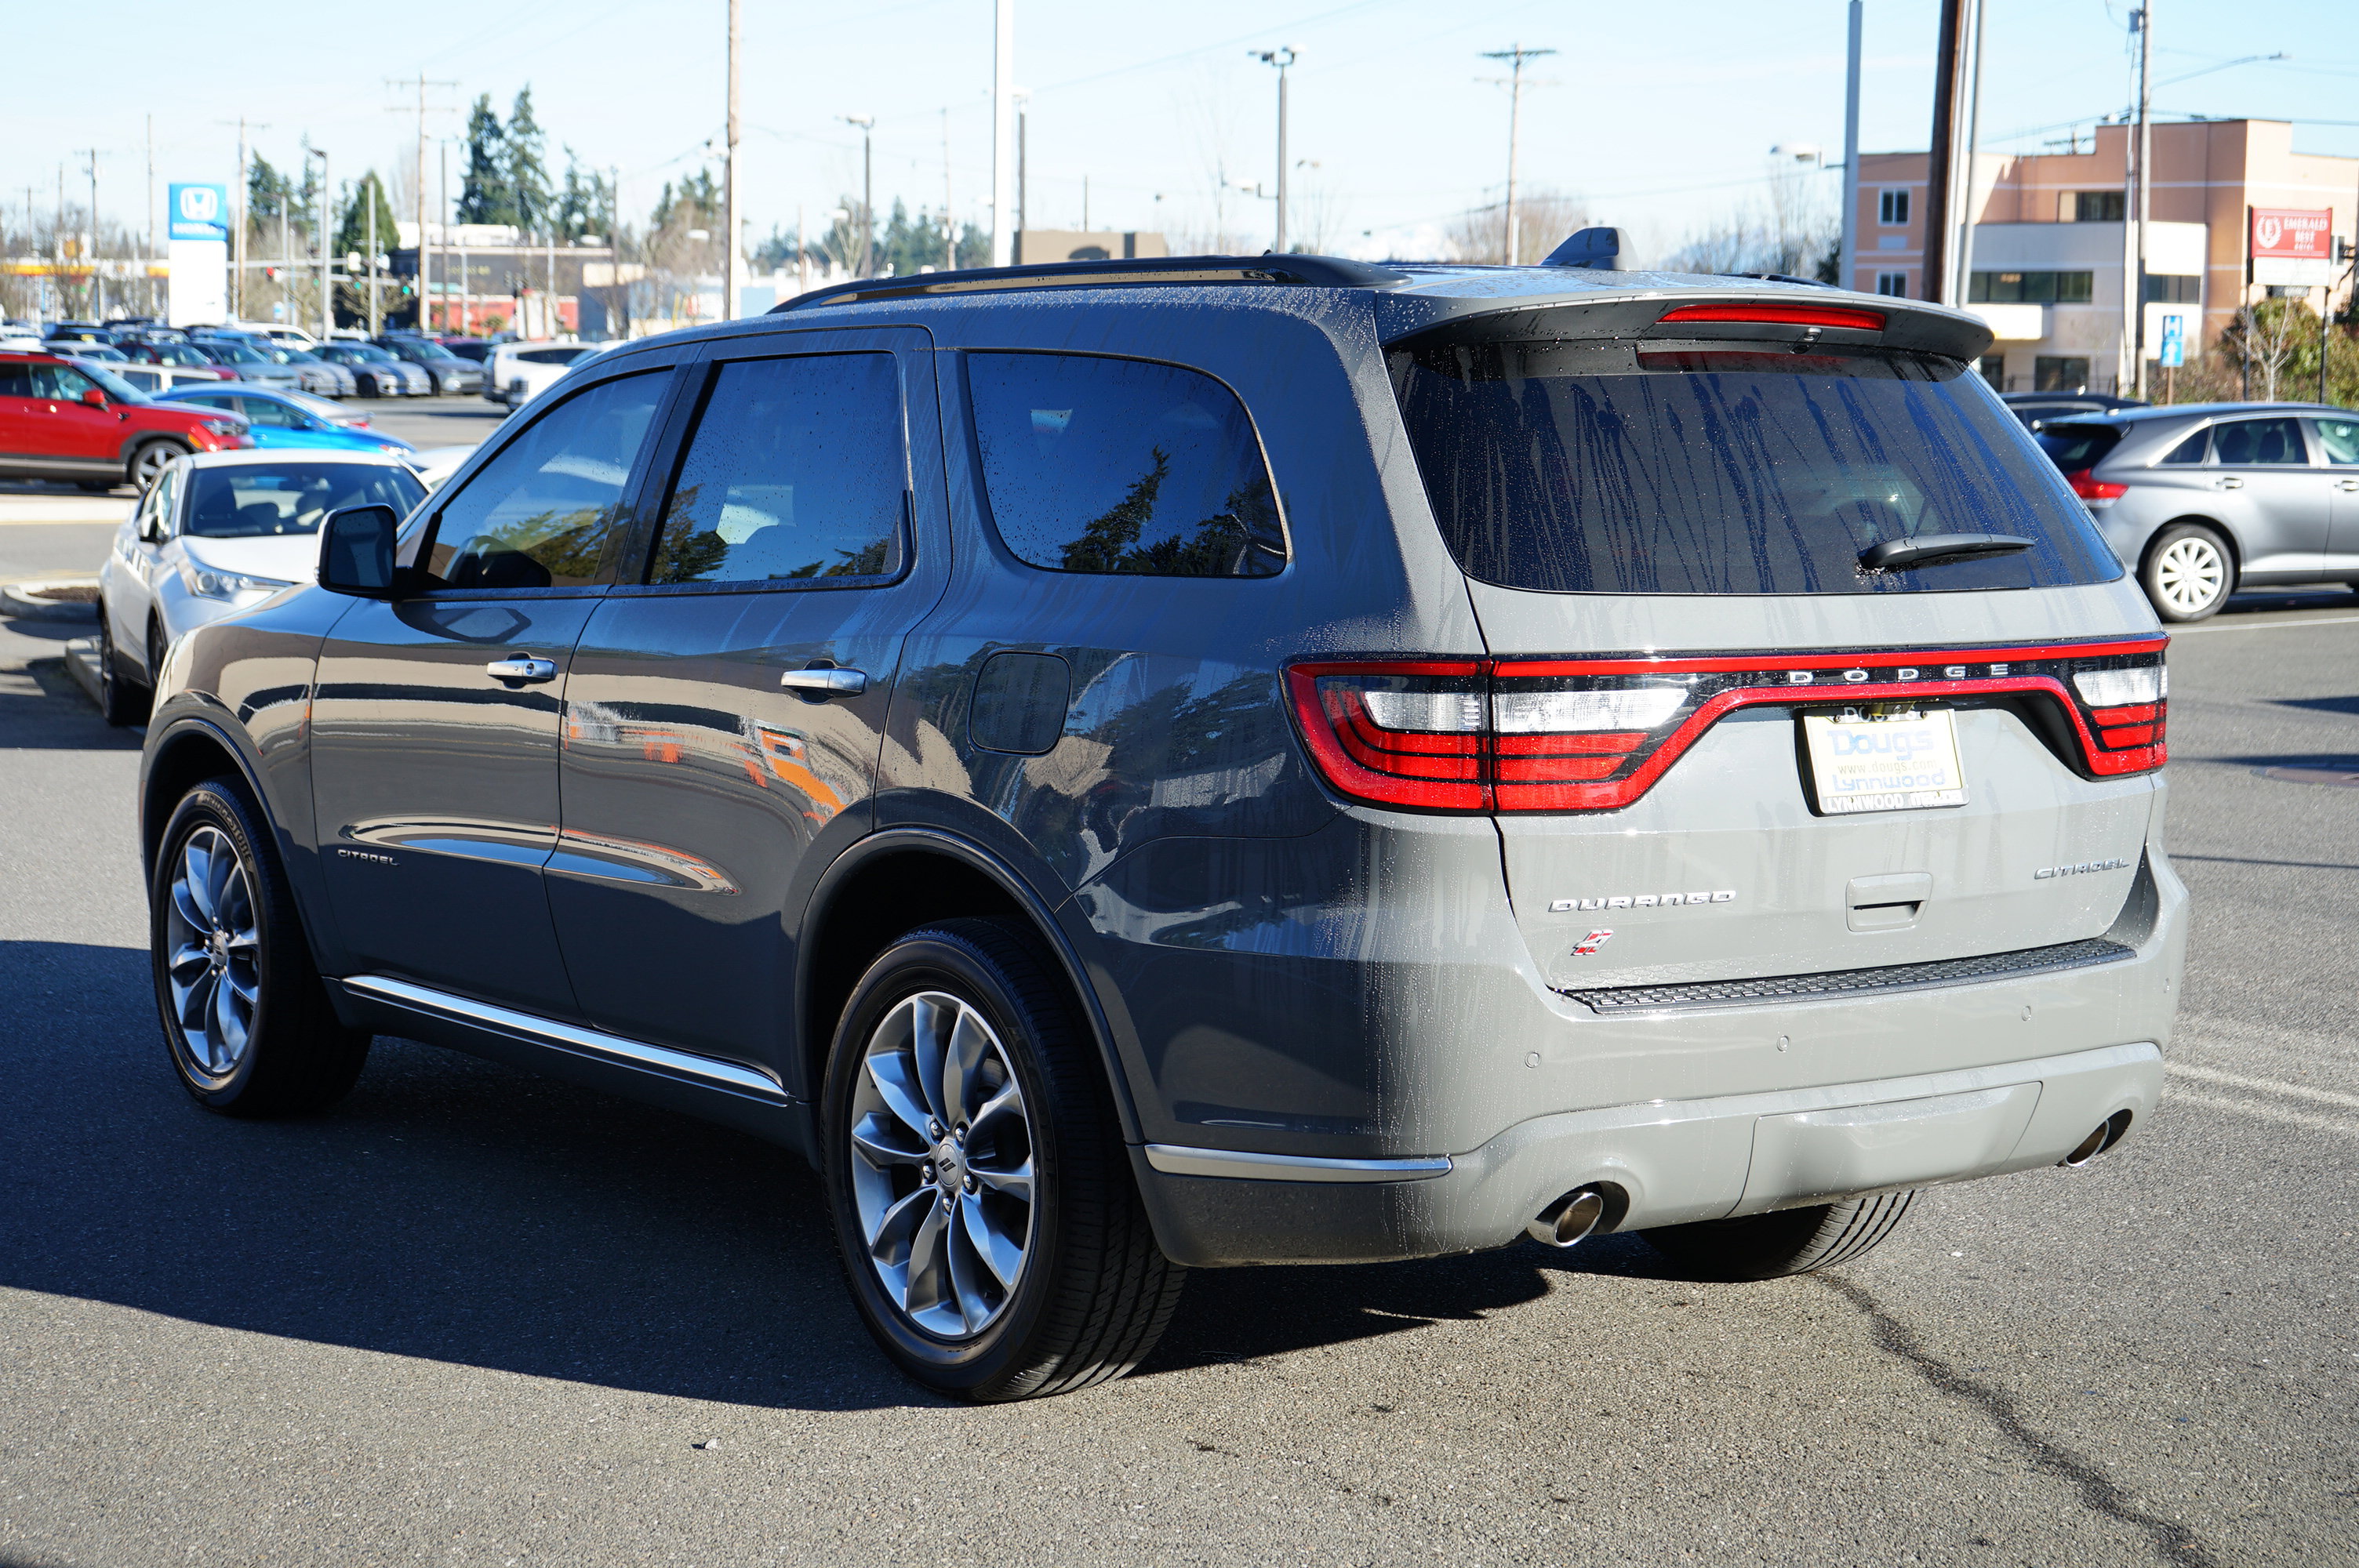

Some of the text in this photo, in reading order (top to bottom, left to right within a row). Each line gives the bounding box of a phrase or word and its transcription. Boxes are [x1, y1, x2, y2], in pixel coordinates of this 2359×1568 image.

[2284, 217, 2328, 231] EMERALD
[2165, 316, 2180, 336] H
[1788, 664, 2009, 684] DODGE
[1837, 759, 1937, 775] www.dougs.com
[1831, 768, 1946, 792] Lynnwood
[1826, 793, 1904, 812] LYNNWOOD
[337, 849, 401, 866] CITADEL
[2034, 858, 2130, 880] CITADEL
[1548, 890, 1737, 913] DURANGO
